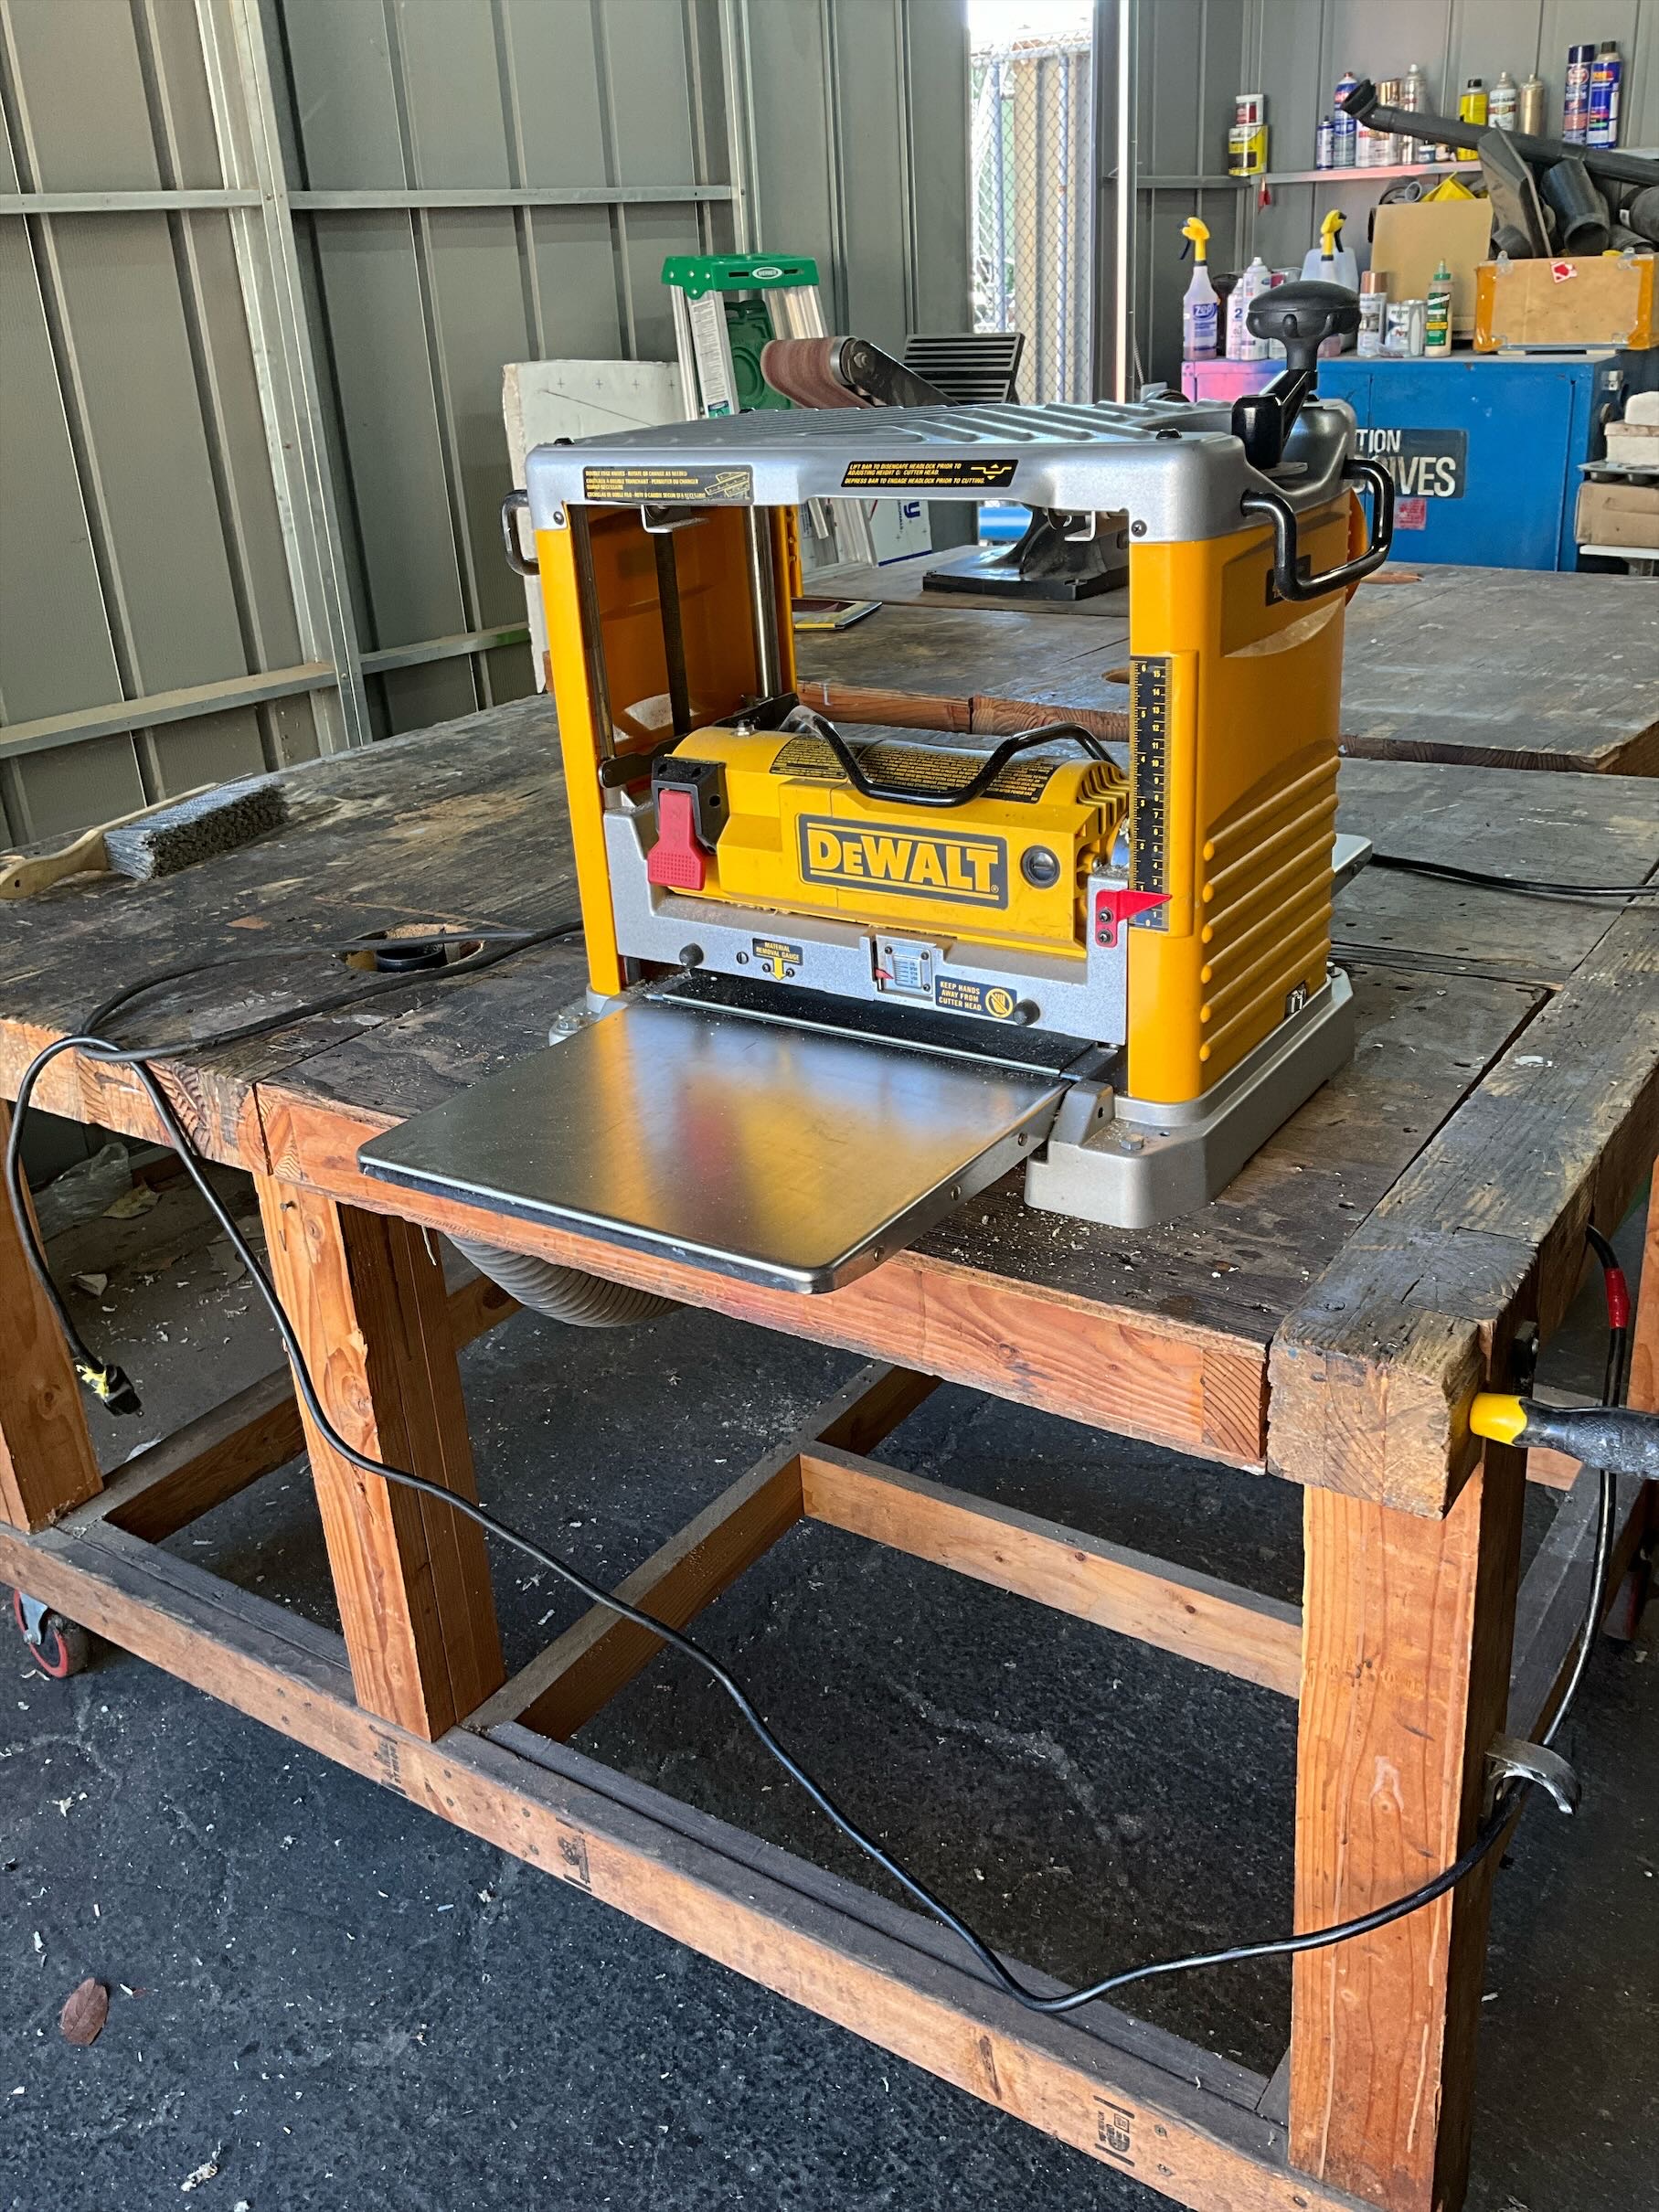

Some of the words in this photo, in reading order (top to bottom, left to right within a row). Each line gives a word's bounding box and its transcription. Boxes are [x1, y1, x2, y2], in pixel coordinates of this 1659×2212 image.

[1153, 670, 1161, 678] 15
[1153, 688, 1160, 697] 14
[1153, 706, 1160, 714] 13
[1152, 724, 1160, 732] 12
[1152, 741, 1159, 750] 11
[1152, 760, 1159, 768] 10
[764, 941, 791, 952] MATERIAL
[755, 946, 780, 958] REMOVAL
[782, 951, 800, 962] GAUGE
[940, 980, 957, 991] KEEP
[958, 984, 981, 995] HANDS
[941, 989, 959, 999] AWAY
[960, 993, 979, 1003] FROM
[938, 996, 962, 1007] CUTTER
